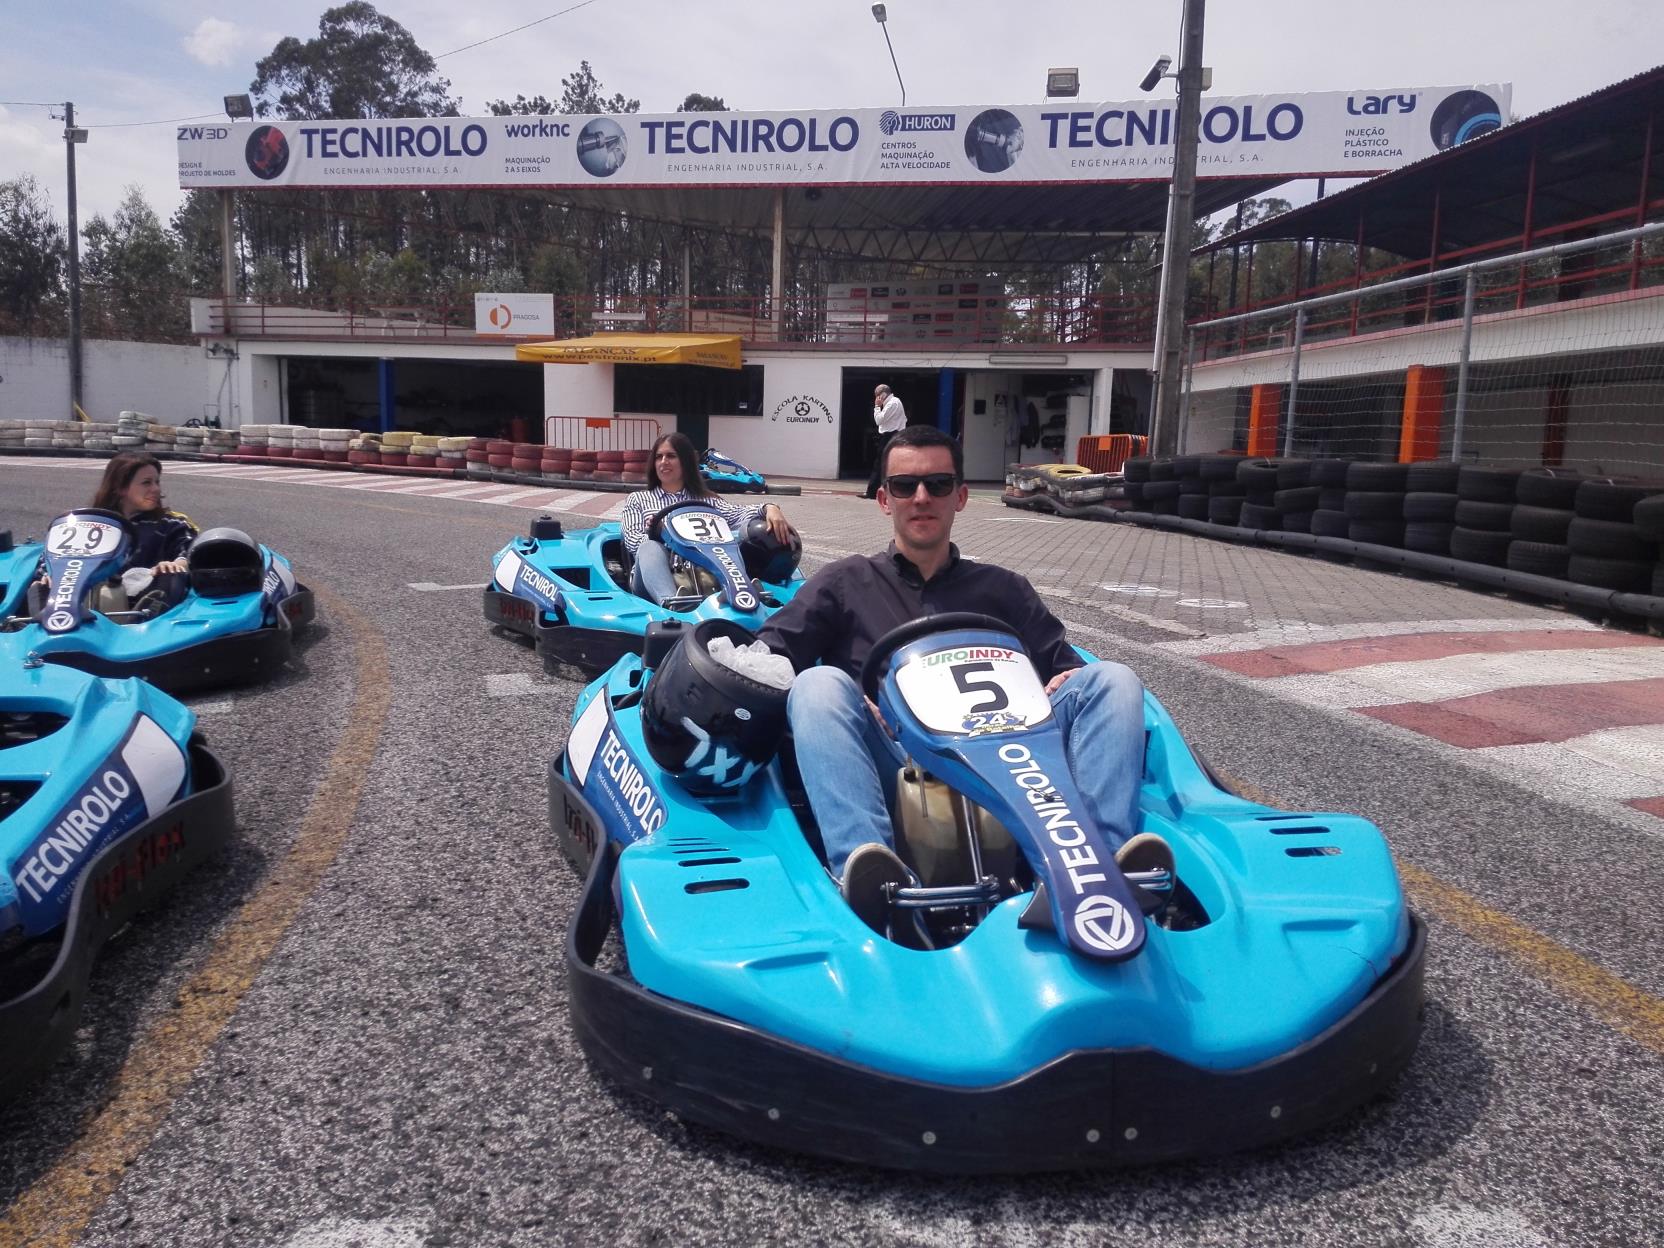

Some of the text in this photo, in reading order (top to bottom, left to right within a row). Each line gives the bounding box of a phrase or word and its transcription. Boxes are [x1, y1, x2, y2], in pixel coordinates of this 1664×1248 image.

[905, 116, 951, 130] HURON
[640, 116, 860, 155] TECNIROLO
[1345, 127, 1385, 137] INJEÇÃO
[299, 124, 488, 159] TECNIROLO
[881, 141, 917, 150] CENTROS
[1344, 138, 1389, 148] PLÁSTICO
[504, 155, 551, 164] MAQUINAÇÃO
[881, 150, 935, 160] MAQUINAÇÃO
[1071, 157, 1148, 168] ENGENHARIA
[1239, 153, 1264, 162] S.A.
[1343, 149, 1403, 158] E BORRACHA
[323, 167, 380, 175] ENGENHARIA
[667, 164, 732, 172] ENGENHARIA
[737, 163, 802, 172] INDUSTRIAL,
[902, 161, 951, 169] VELOCIDADE
[771, 394, 834, 423] ESCOLA KARTING
[688, 517, 723, 539] 31
[56, 526, 104, 550] 29
[949, 661, 1009, 714] 5
[998, 743, 1108, 896] TECNIROLO
[15, 769, 131, 904] TECNIROLO
